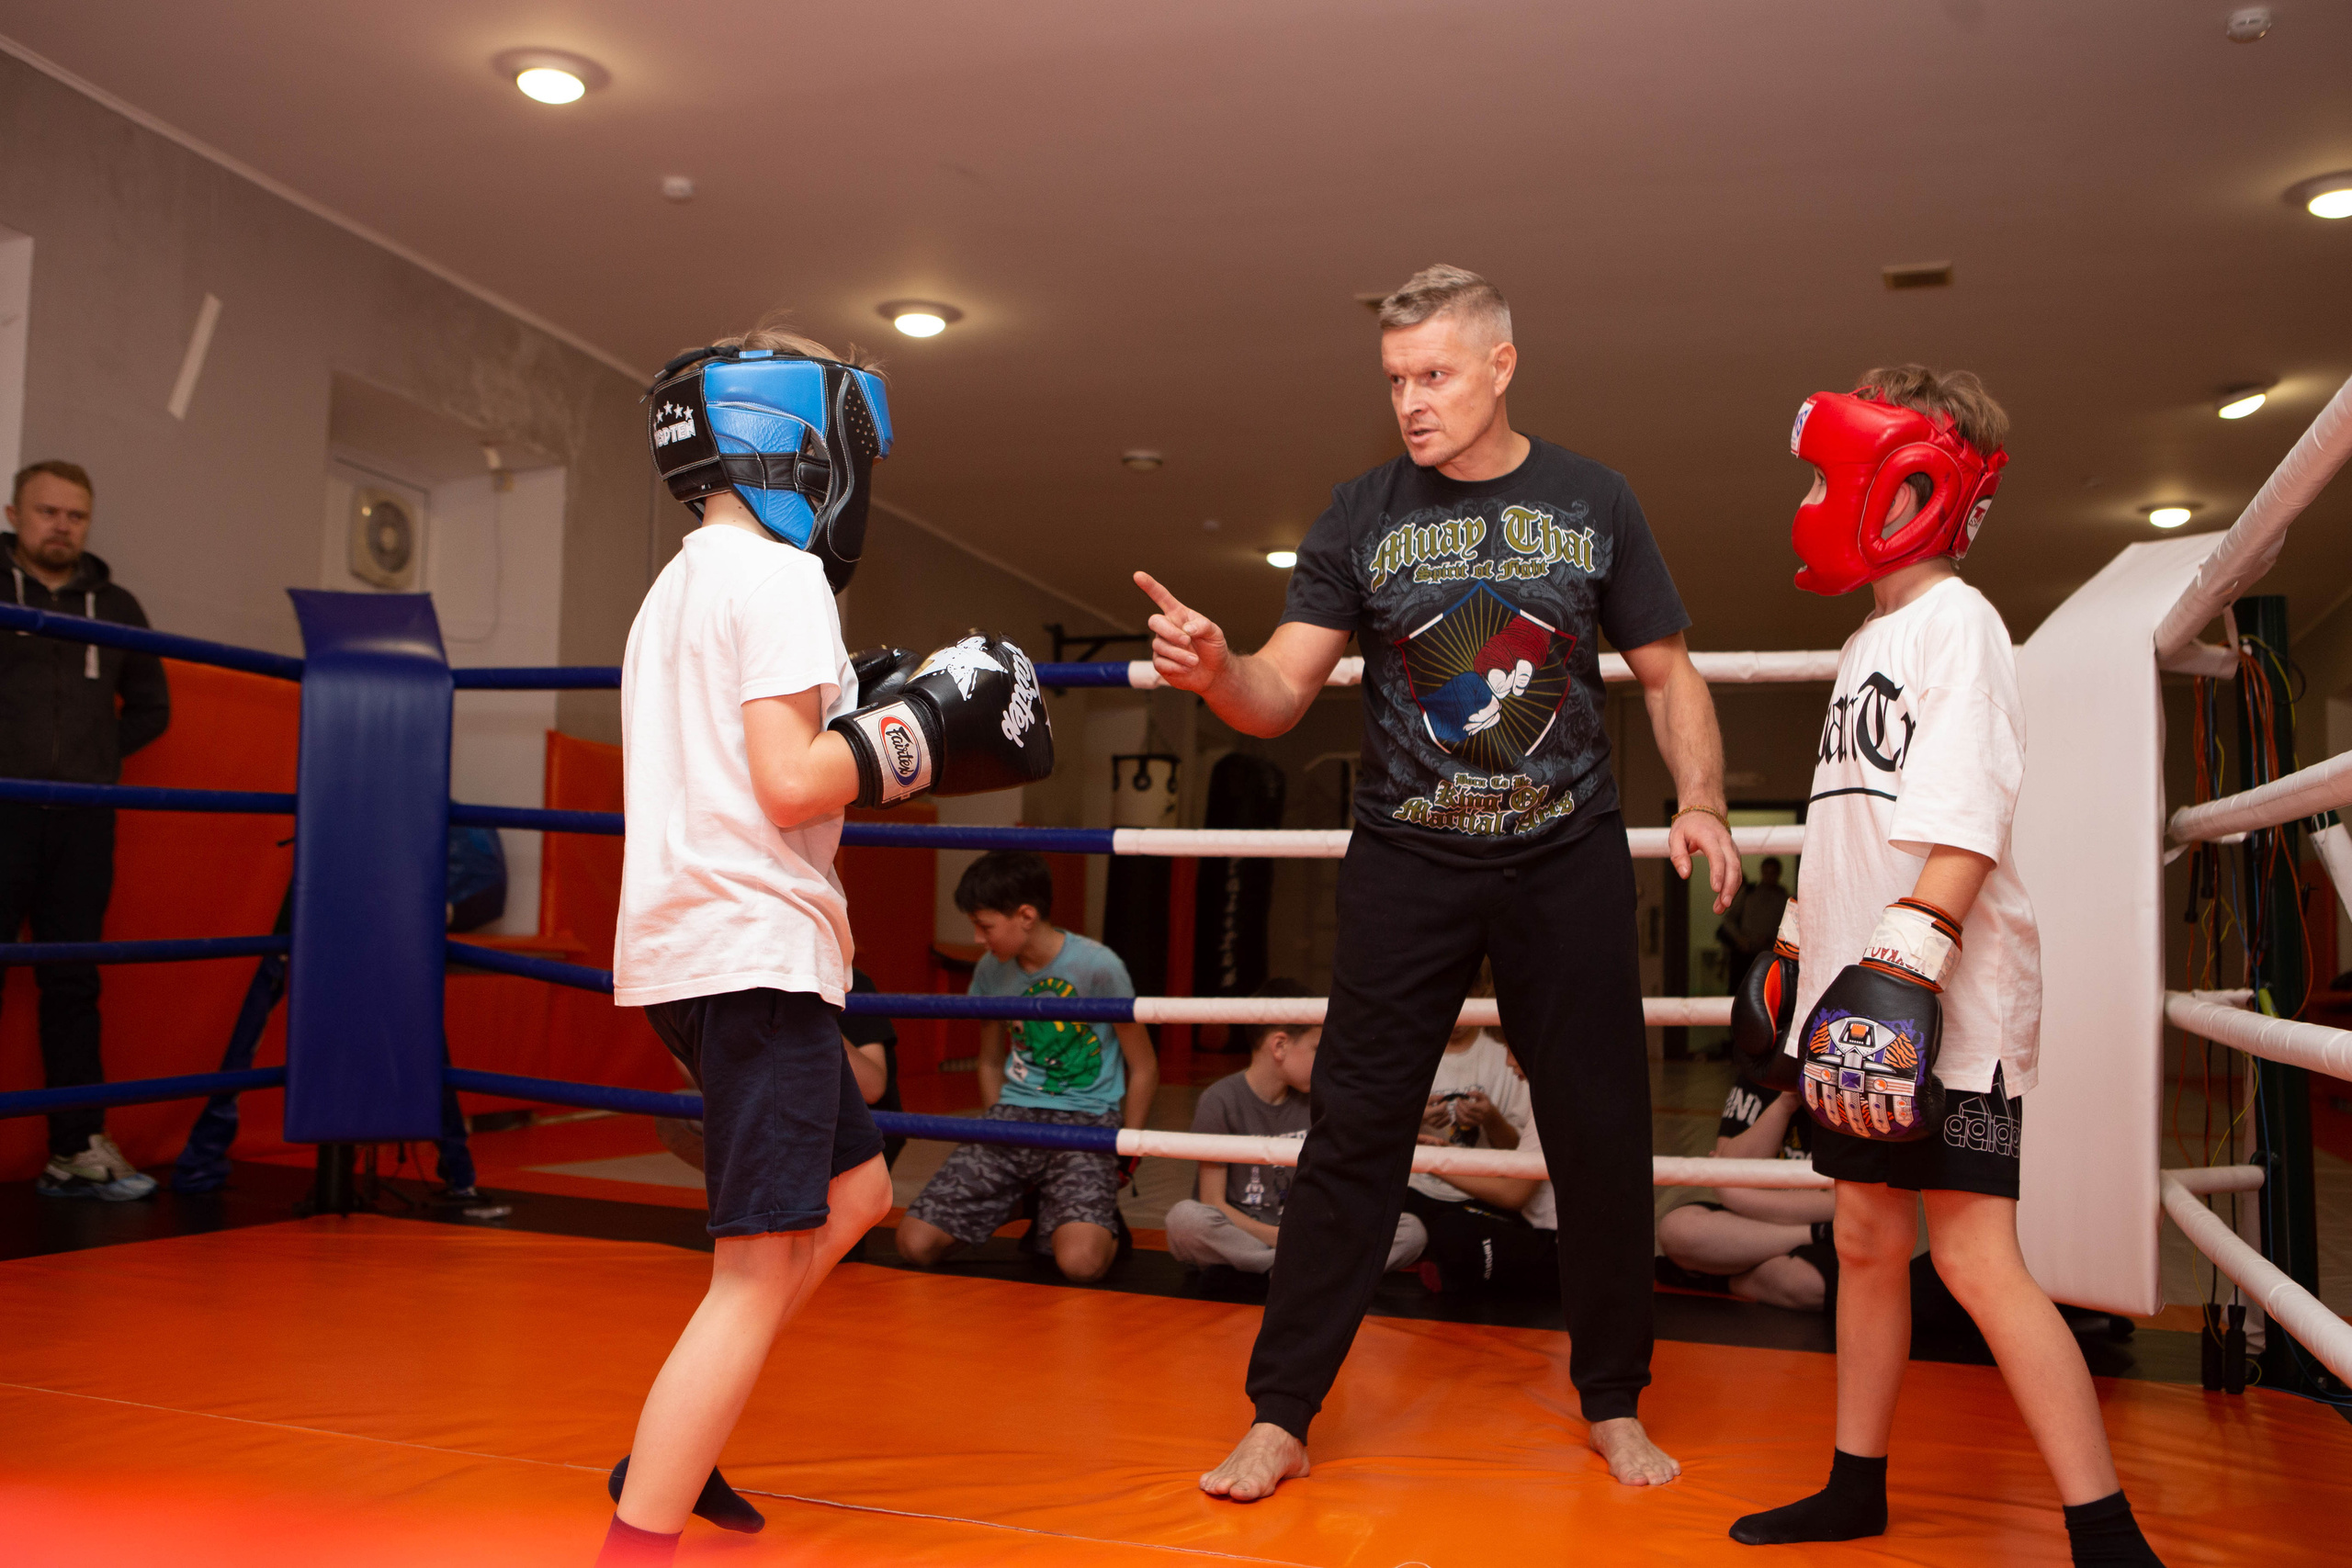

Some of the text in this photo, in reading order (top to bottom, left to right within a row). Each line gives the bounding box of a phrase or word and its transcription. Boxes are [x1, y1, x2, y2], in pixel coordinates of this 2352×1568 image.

[1369, 505, 1595, 593] Muay Thai
[1413, 557, 1549, 584] Spirit of Fight
[886, 726, 913, 775] Fairtex
[1434, 780, 1550, 813] King Of
[1453, 773, 1532, 790] Born To Be
[1393, 791, 1575, 836] Martial Arts
